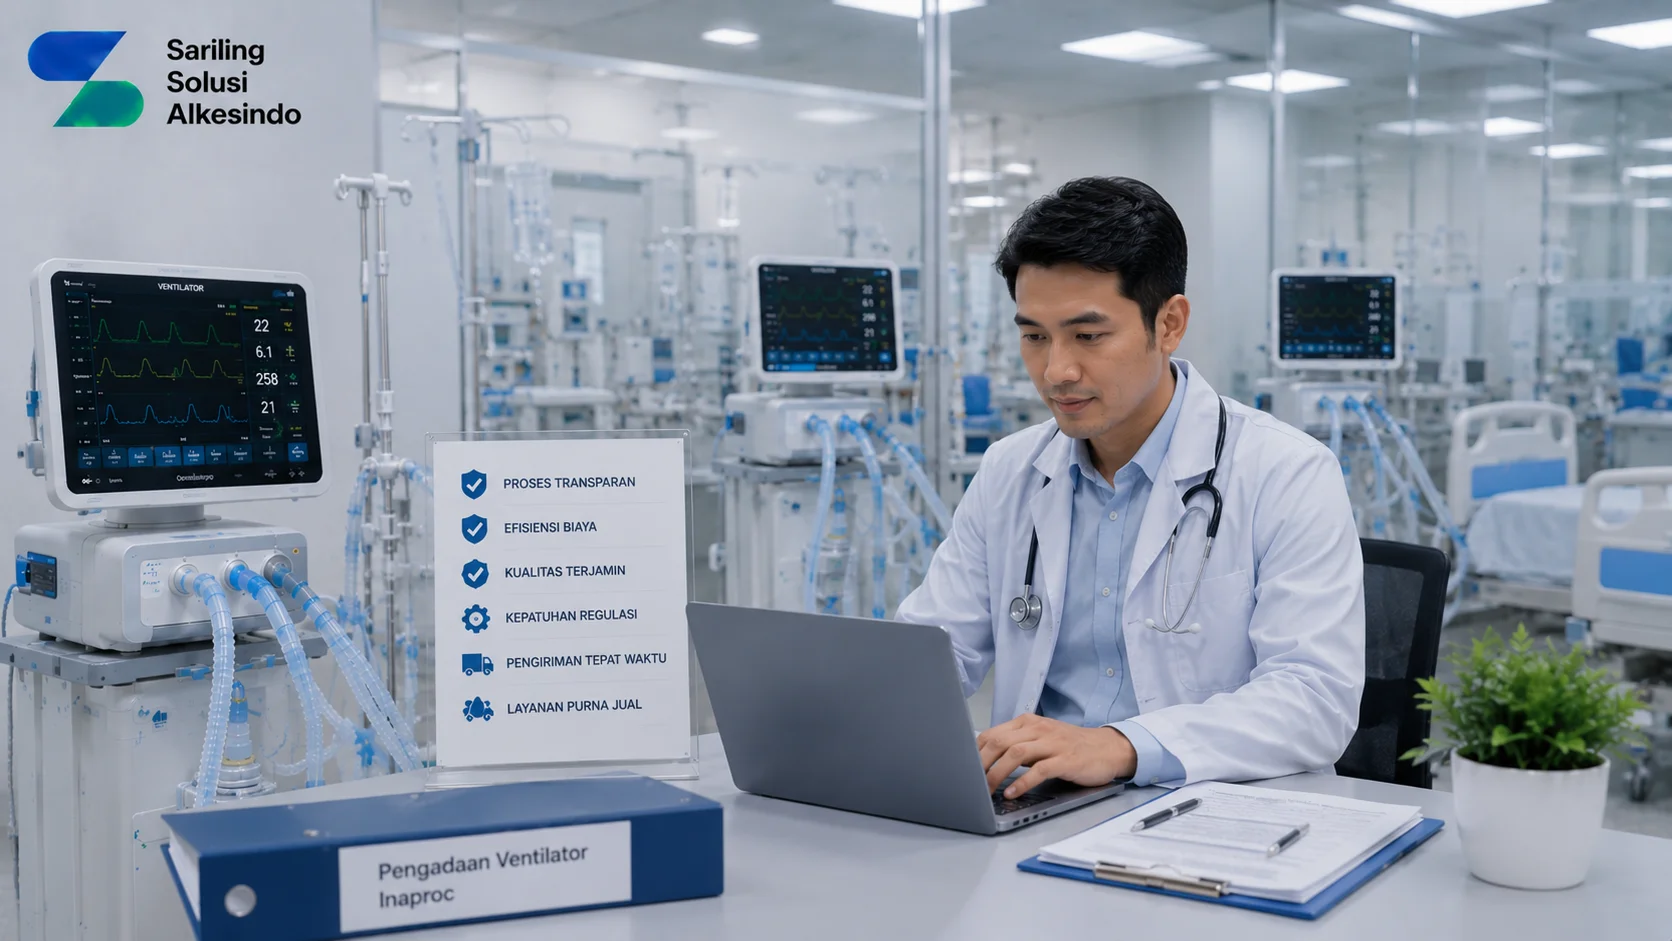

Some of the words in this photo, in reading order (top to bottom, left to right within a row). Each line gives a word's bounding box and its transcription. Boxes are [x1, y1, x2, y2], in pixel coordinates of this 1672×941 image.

[157, 282, 205, 293] VENTILATOR
[253, 318, 270, 333] 22
[255, 345, 273, 358] 6.1
[255, 372, 279, 386] 258
[260, 400, 276, 414] 21
[503, 477, 552, 490] PROSES
[554, 476, 636, 489] TRANSPARAN
[504, 521, 560, 534] EFISIENSI
[563, 520, 597, 533] BIAYA
[504, 566, 563, 579] KUALITAS
[565, 564, 626, 577] TERJAMIN
[505, 610, 577, 624] KEPATUHAN
[579, 608, 638, 621] REGULASI
[506, 655, 582, 669] PENGIRIMAN
[585, 654, 622, 666] TEPAT
[624, 652, 667, 665] WAKTU
[507, 701, 564, 715] LAYANAN
[567, 700, 609, 712] PURNA
[612, 698, 643, 711] JUAL
[379, 856, 490, 880] Pengadaan
[496, 845, 588, 868] Ventilator
[380, 886, 455, 909] Inaproc
